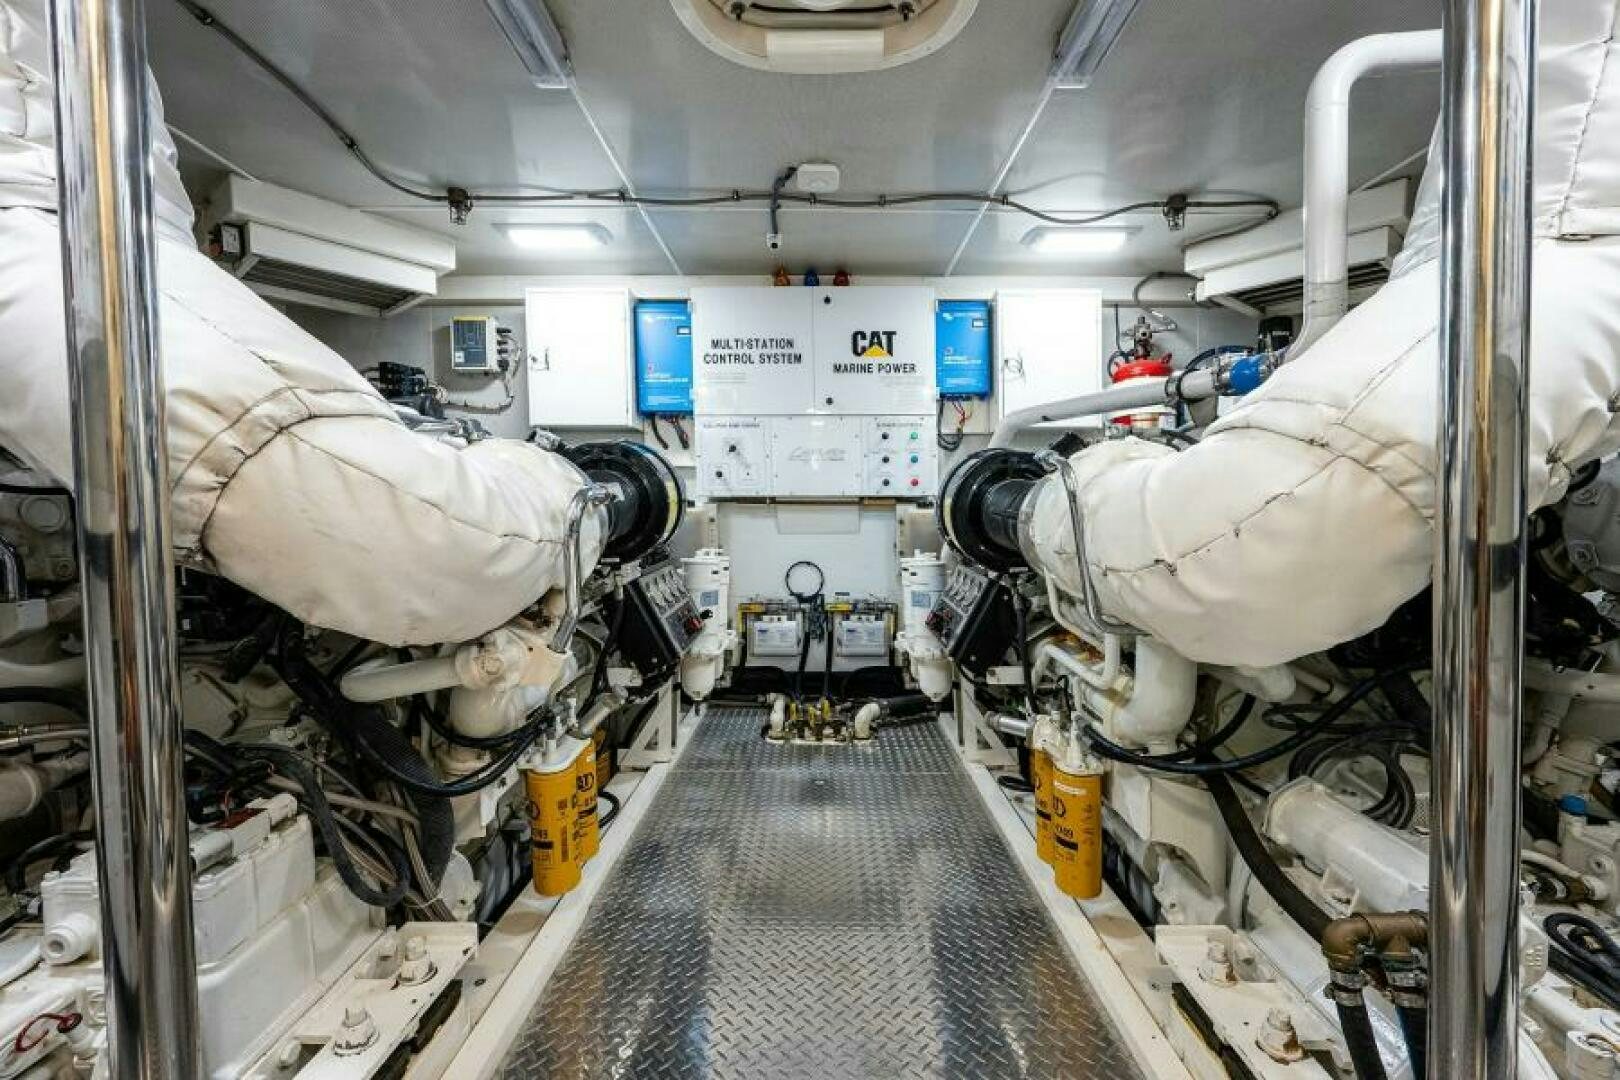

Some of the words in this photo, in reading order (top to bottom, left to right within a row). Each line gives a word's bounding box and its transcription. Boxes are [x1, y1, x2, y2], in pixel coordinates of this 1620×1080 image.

[711, 338, 794, 350] MULTI-STATION
[852, 331, 897, 357] CAT
[704, 353, 754, 364] CONTROL
[759, 352, 802, 364] SYSTEM
[833, 363, 874, 374] MARINE
[878, 363, 917, 374] POWER
